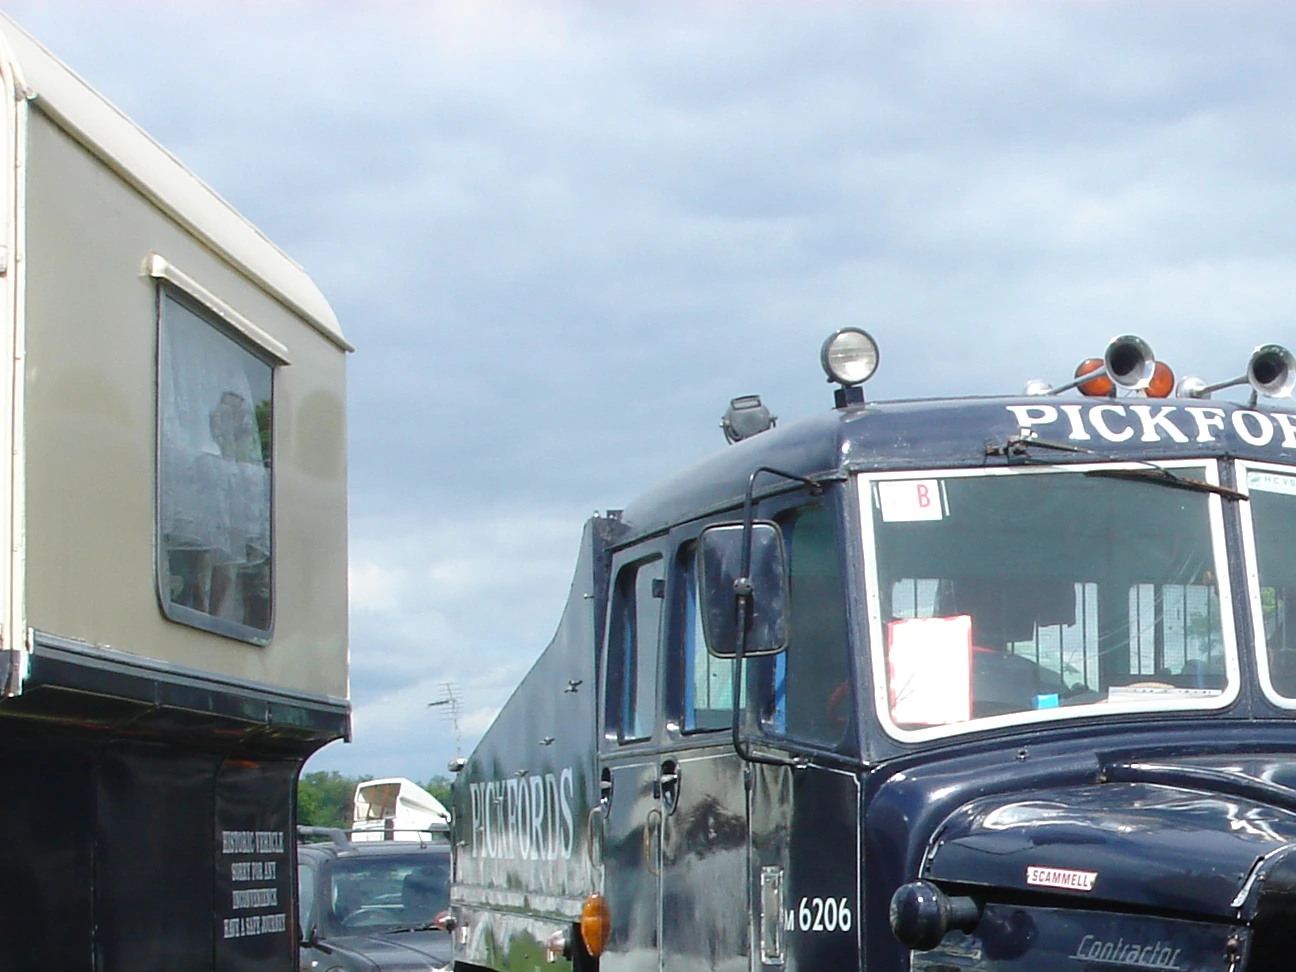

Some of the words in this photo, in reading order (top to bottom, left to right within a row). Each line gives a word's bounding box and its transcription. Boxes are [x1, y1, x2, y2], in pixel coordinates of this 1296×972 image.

[916, 484, 931, 508] B
[470, 767, 574, 861] PICKFORDS
[1031, 869, 1088, 888] SCAMMELL
[799, 897, 851, 932] 6206
[1072, 935, 1181, 968] Contractor
